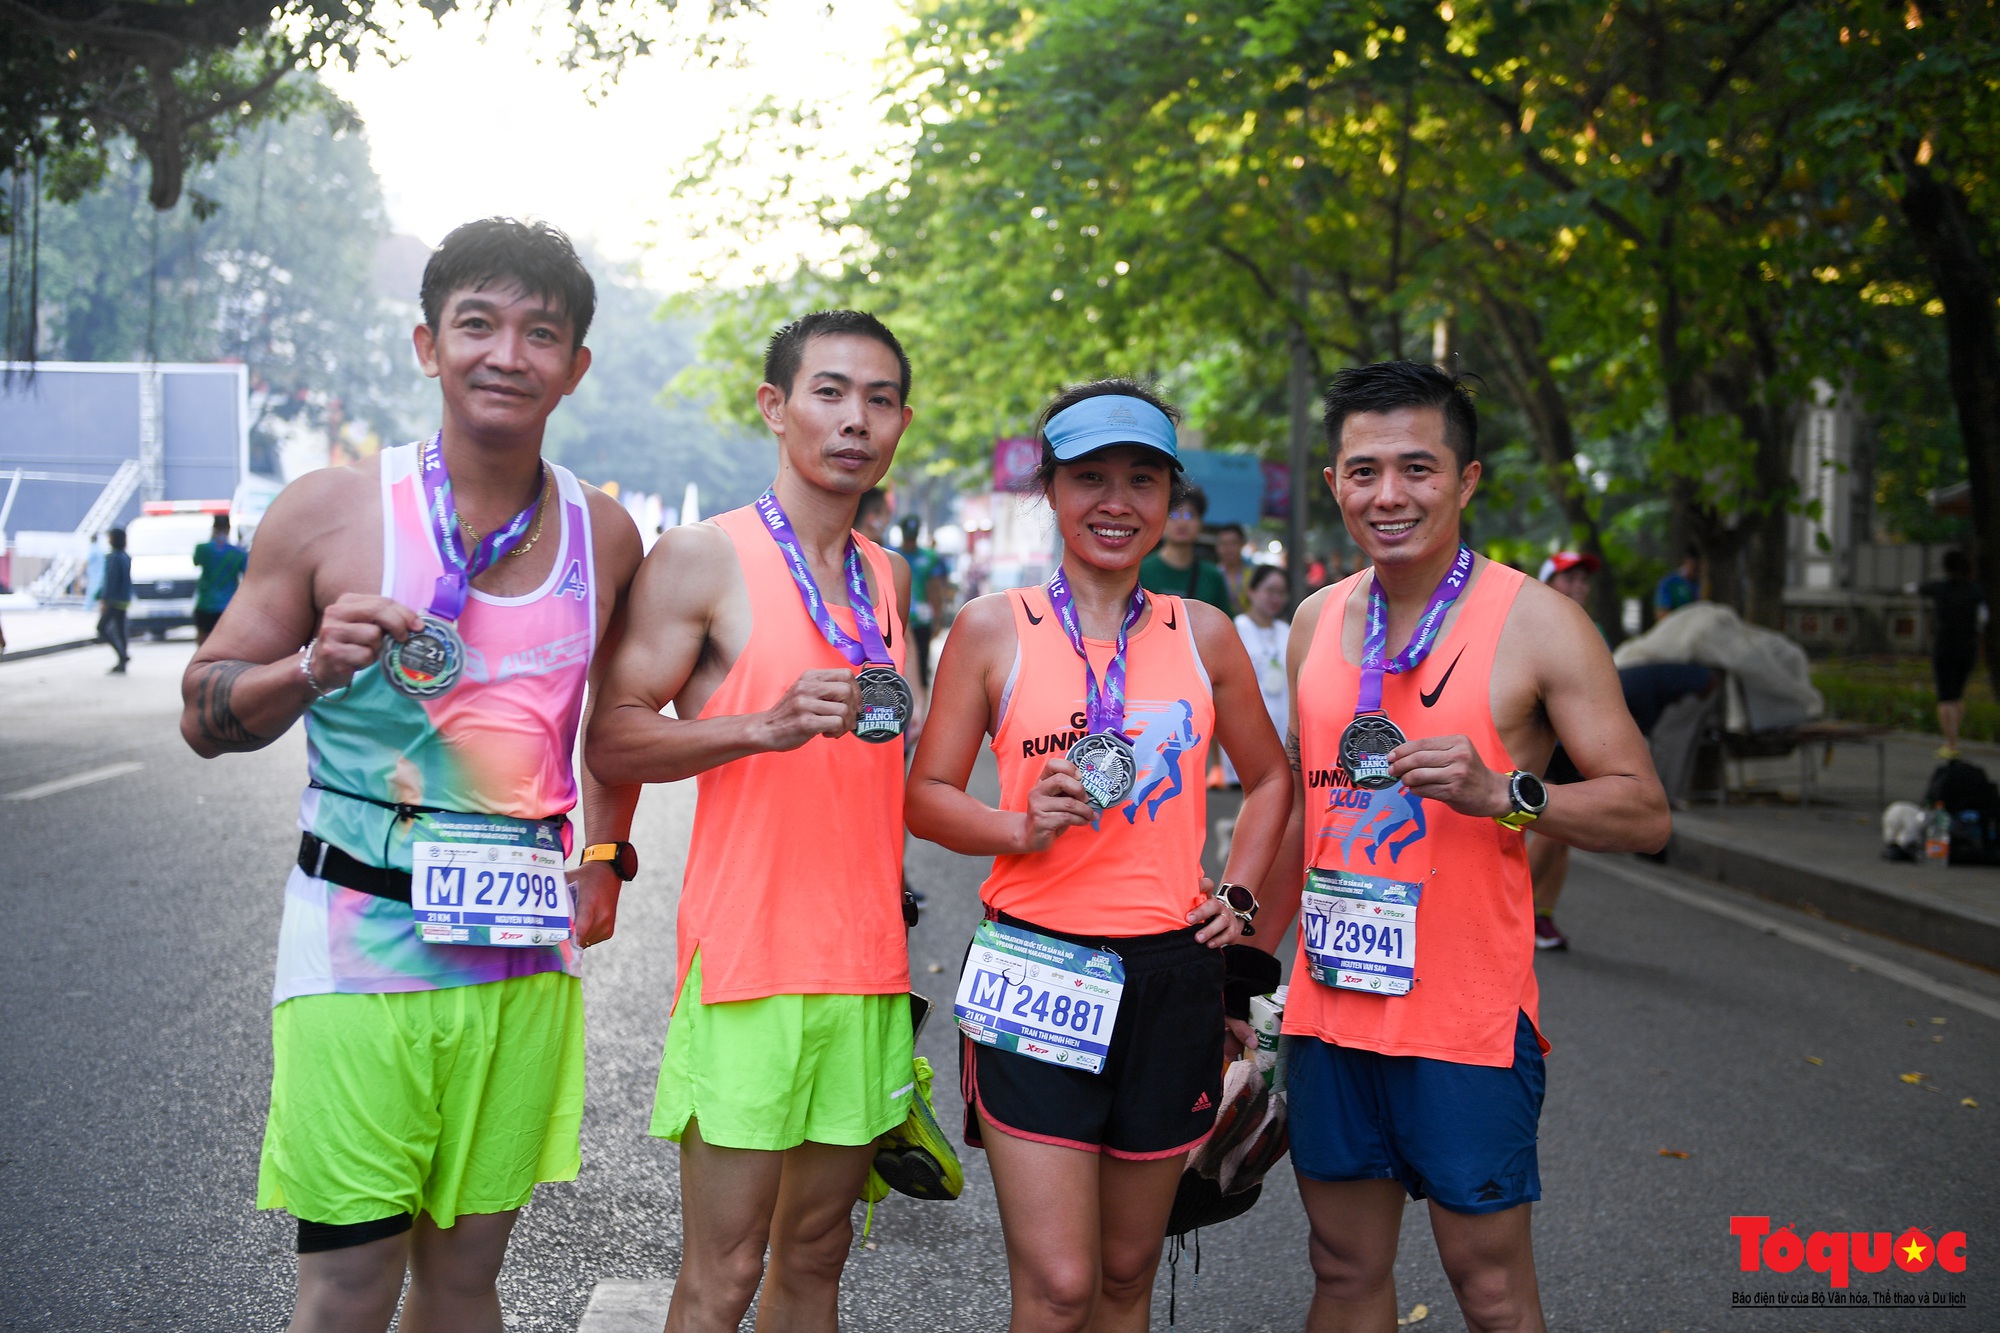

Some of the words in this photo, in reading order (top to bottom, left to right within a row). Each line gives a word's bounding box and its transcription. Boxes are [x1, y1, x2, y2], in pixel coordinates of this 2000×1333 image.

[757, 494, 772, 508] 21
[765, 507, 783, 529] KM
[1447, 569, 1464, 588] 21
[1457, 548, 1471, 570] KM
[795, 563, 806, 579] HANOI
[801, 579, 817, 607] MARATHON
[1051, 582, 1065, 598] 21
[1425, 600, 1443, 626] MARATHON
[426, 647, 445, 661] 21
[858, 721, 900, 734] MARATHON
[1023, 731, 1089, 758] RUNN
[1329, 789, 1372, 809] CLUB
[430, 868, 458, 904] M
[475, 870, 558, 909] 27998
[1383, 909, 1405, 918] VPBank
[1307, 915, 1323, 948] M
[1333, 920, 1403, 959] 23941
[1341, 960, 1362, 969] NGUYEN
[1362, 962, 1373, 971] VAN
[1374, 964, 1386, 972] SAM
[1085, 984, 1110, 995] VPBank
[974, 973, 1004, 1009] M
[1012, 984, 1104, 1036] 24881
[965, 1010, 973, 1019] 21
[974, 1013, 986, 1022] KM
[1021, 1026, 1037, 1036] TRAN
[1038, 1031, 1048, 1039] THI
[1048, 1034, 1064, 1043] MINH
[1065, 1037, 1079, 1046] HIEN
[1192, 1102, 1212, 1112] adidas
